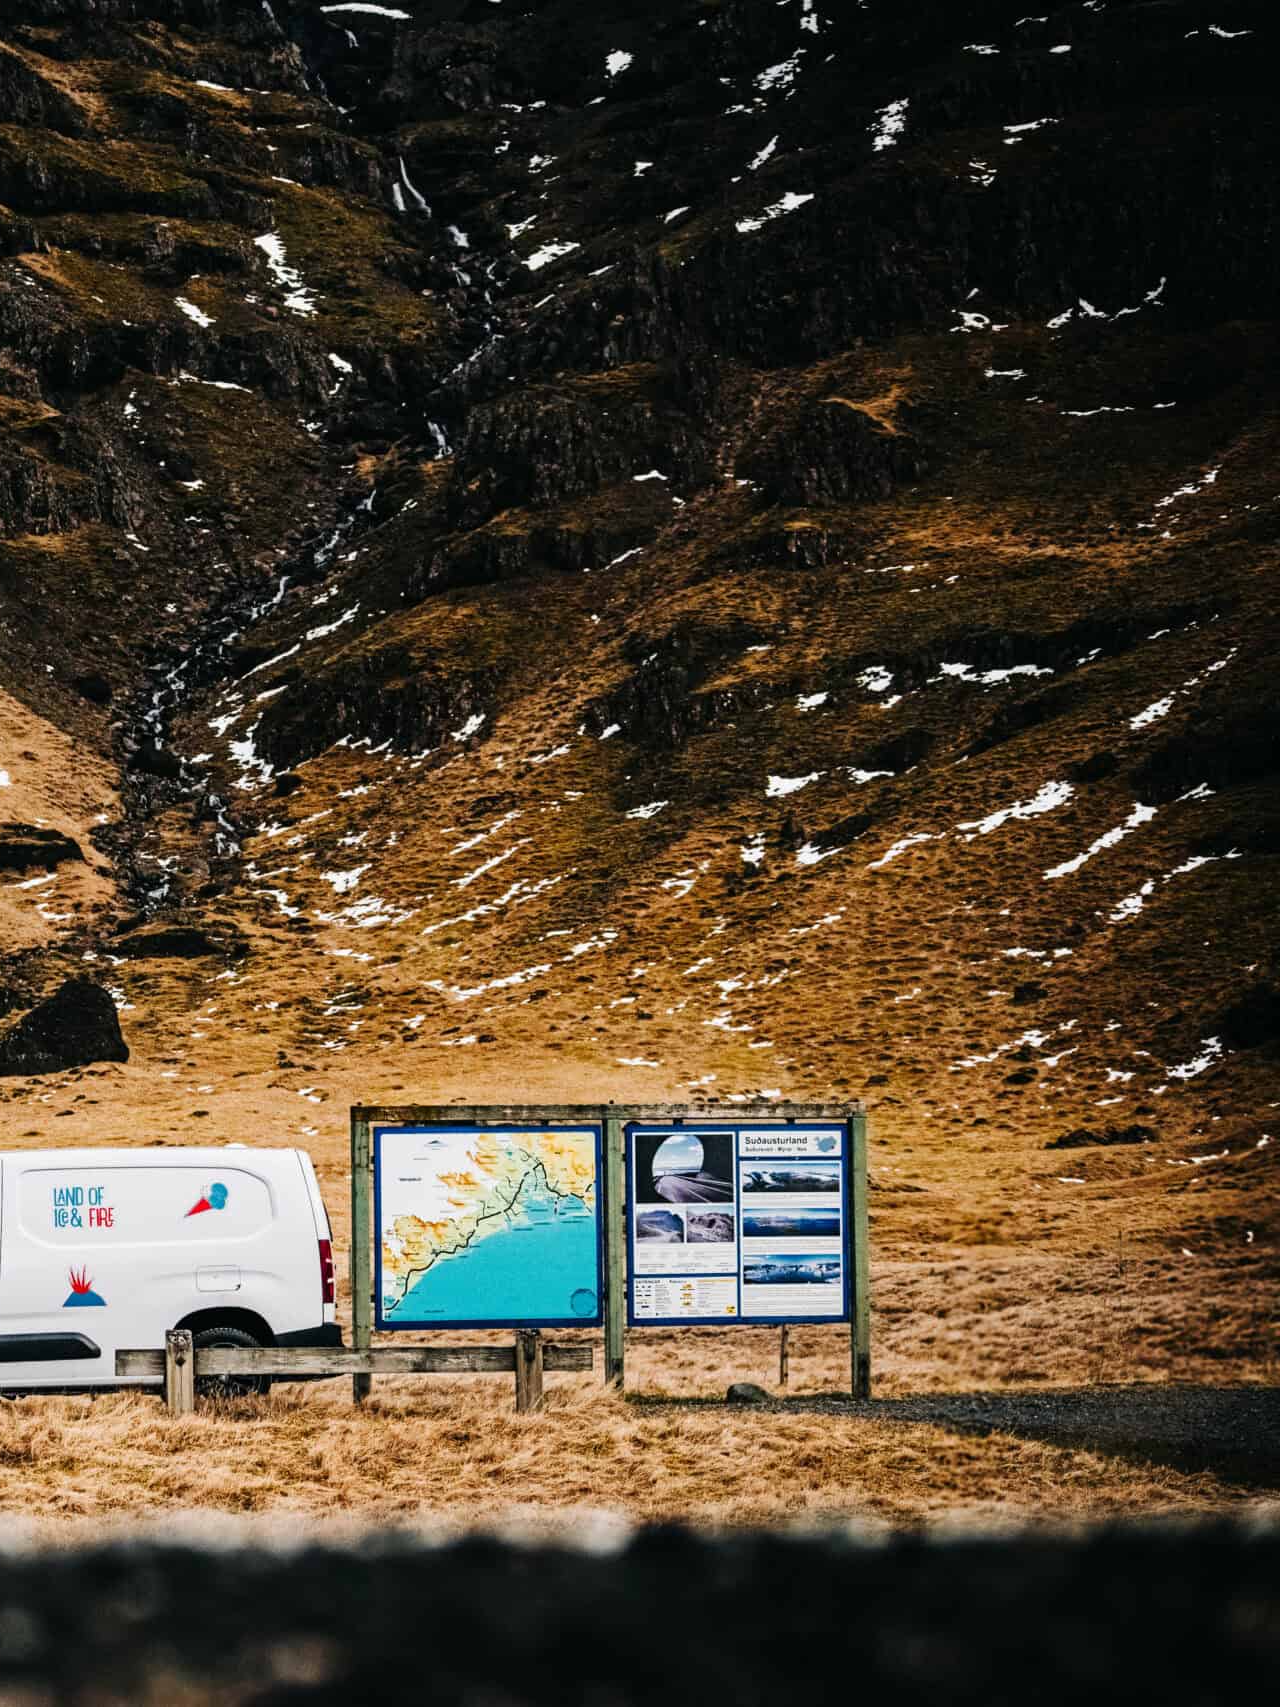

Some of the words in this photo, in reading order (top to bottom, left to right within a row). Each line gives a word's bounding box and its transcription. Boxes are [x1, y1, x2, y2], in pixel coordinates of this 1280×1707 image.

[745, 1136, 808, 1145] Suðausturland
[54, 1186, 84, 1207] LAND
[88, 1186, 104, 1206] OF
[70, 1207, 82, 1228] &
[88, 1207, 114, 1228] FIRE
